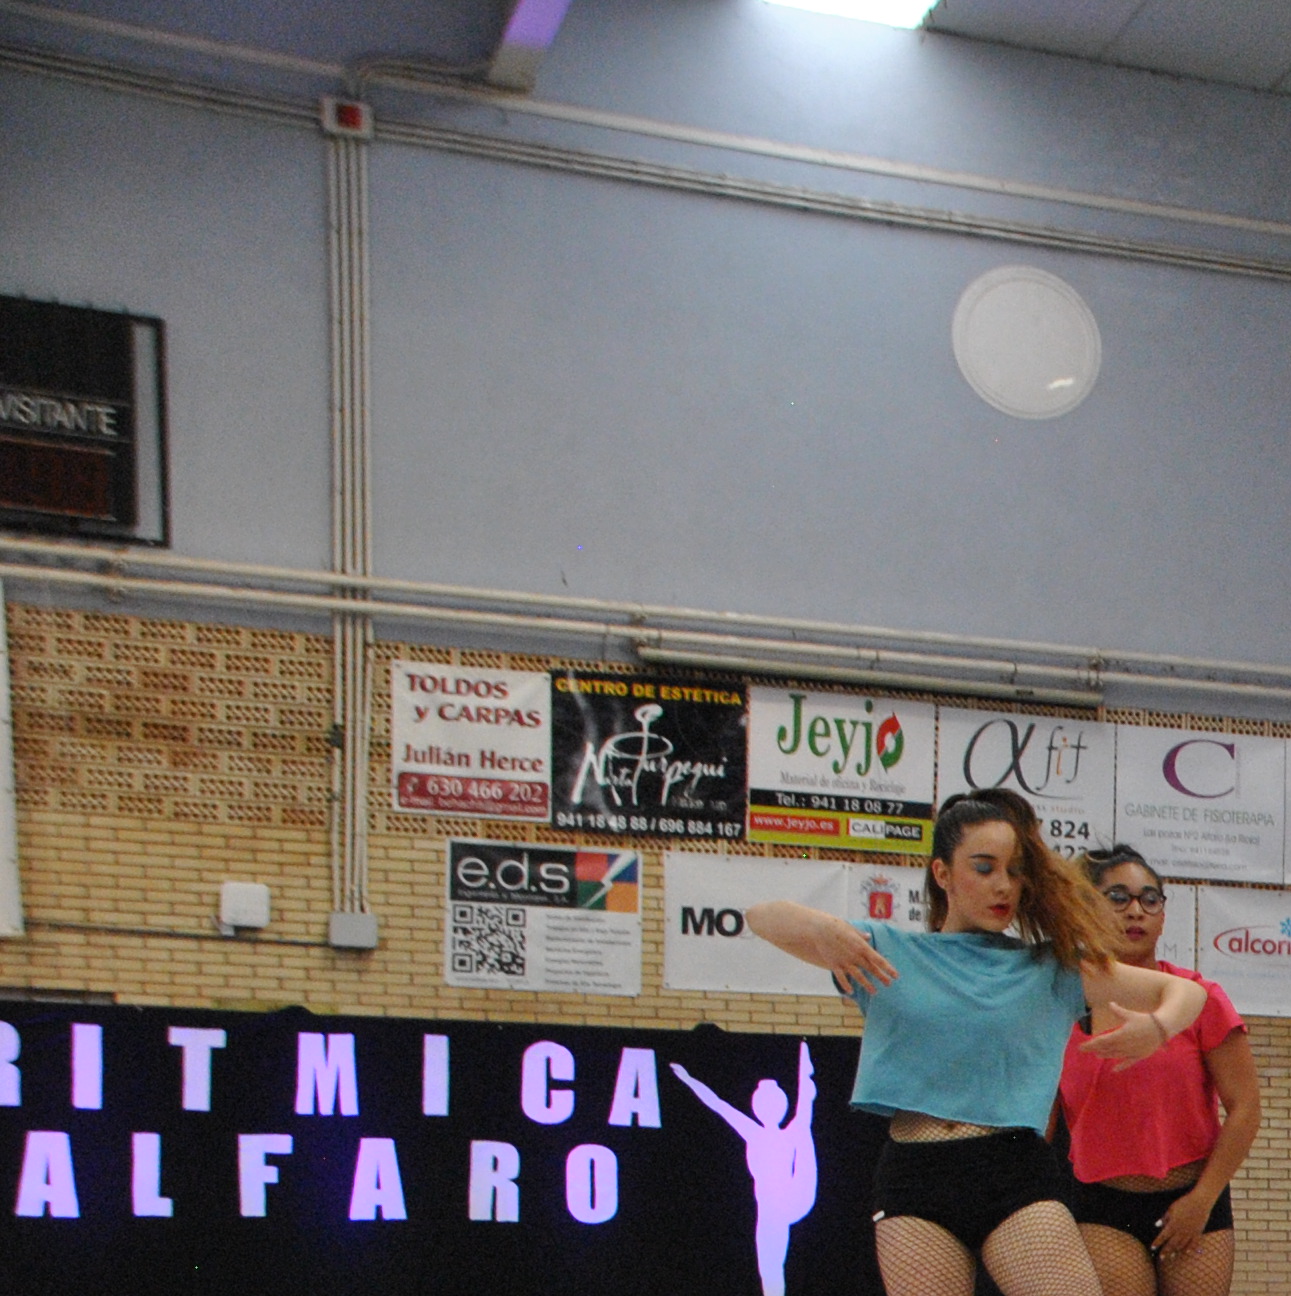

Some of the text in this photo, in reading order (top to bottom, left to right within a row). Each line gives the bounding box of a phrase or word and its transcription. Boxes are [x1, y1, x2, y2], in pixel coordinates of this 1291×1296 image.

[406, 673, 509, 699] TOLDOS
[555, 678, 628, 697] CENTRO
[632, 683, 655, 698] DE
[414, 703, 542, 728] y CARPAS
[777, 693, 904, 776] Jeyjo
[480, 749, 544, 773] Herce
[426, 777, 543, 802] 630 466 202
[811, 796, 837, 809] 941
[844, 798, 859, 812] 18
[864, 800, 881, 813] 08
[887, 802, 904, 815] 77
[1125, 803, 1275, 826] GABINETE DE FISIOTERAPIA
[557, 812, 583, 827] 941
[589, 814, 607, 828] 18
[717, 822, 741, 837] 167
[753, 814, 835, 831] www.jeyjo.es
[16, 1130, 619, 1224] ALFARO
